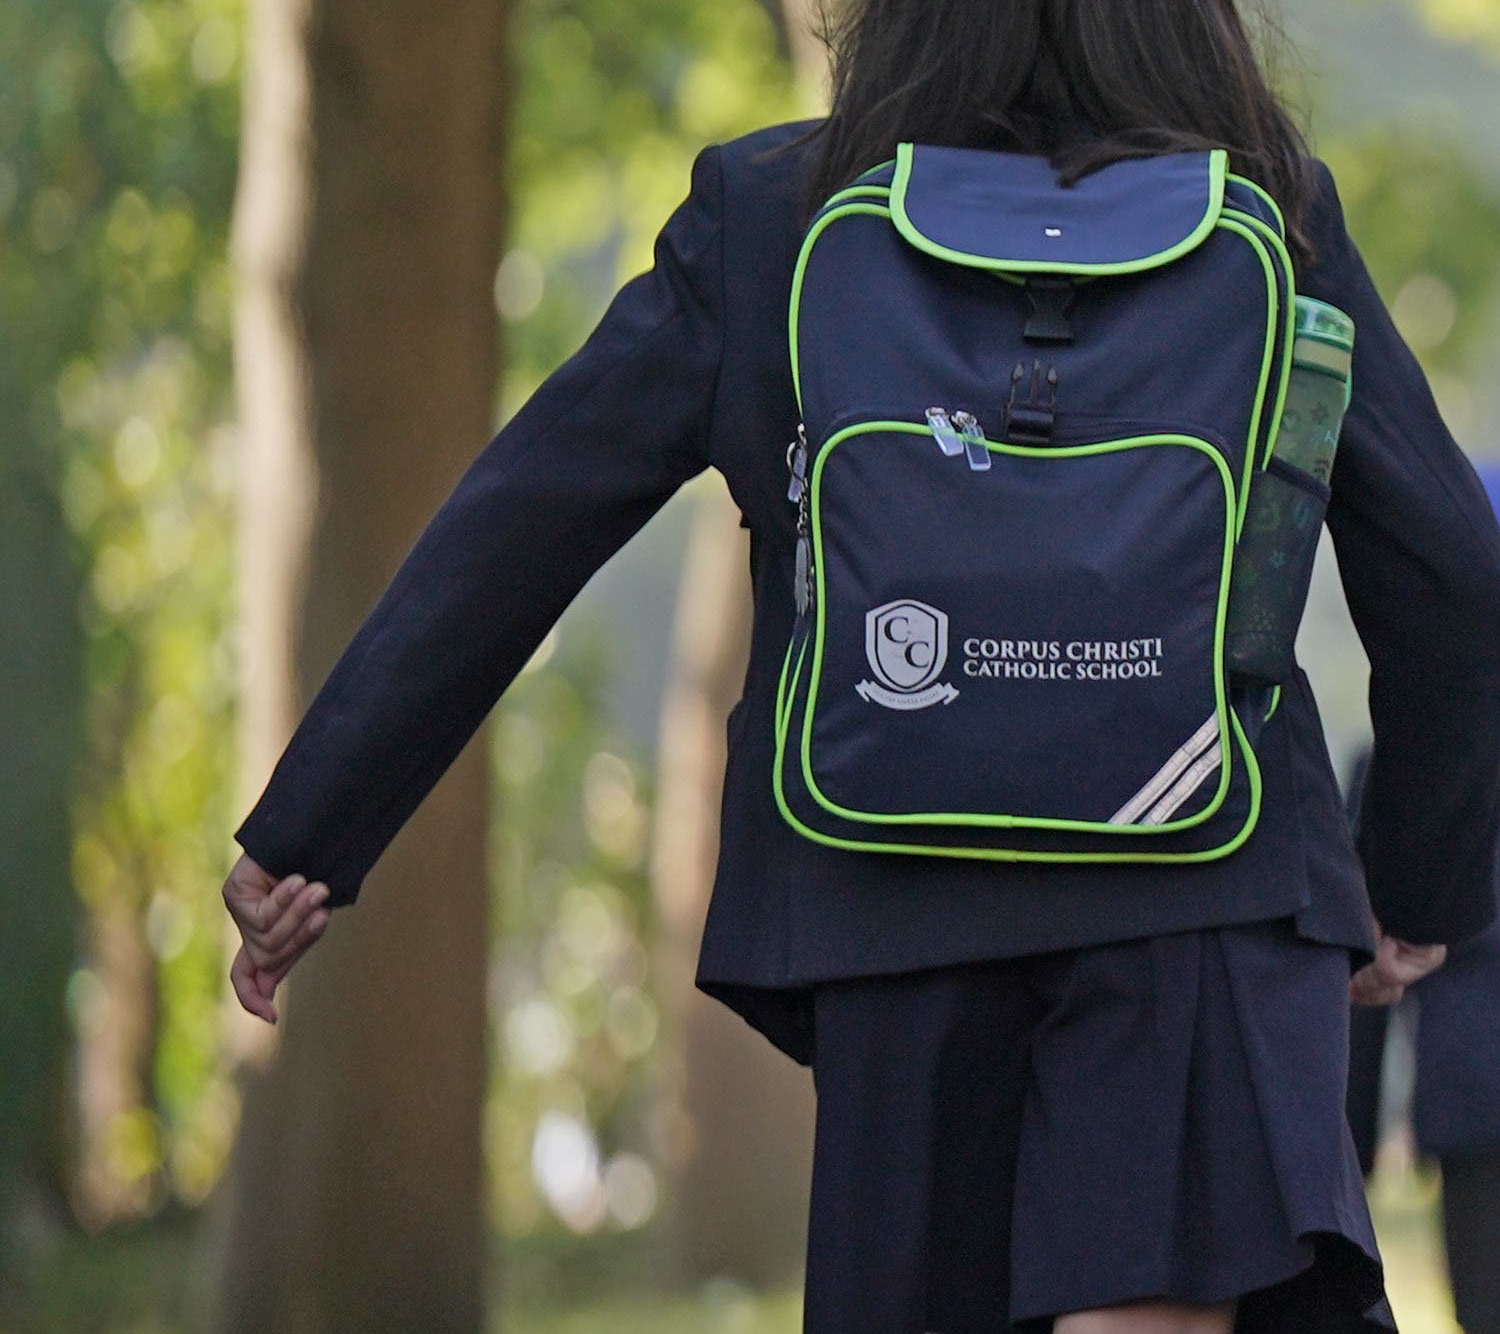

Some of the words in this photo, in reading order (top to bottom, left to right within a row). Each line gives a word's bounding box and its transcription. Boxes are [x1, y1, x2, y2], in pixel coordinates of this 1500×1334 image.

[963, 638, 1060, 660] CORPUS
[1066, 638, 1163, 661] CHRISTI
[963, 660, 1072, 680] CATHOLIC
[1076, 660, 1162, 680] SCHOOL
